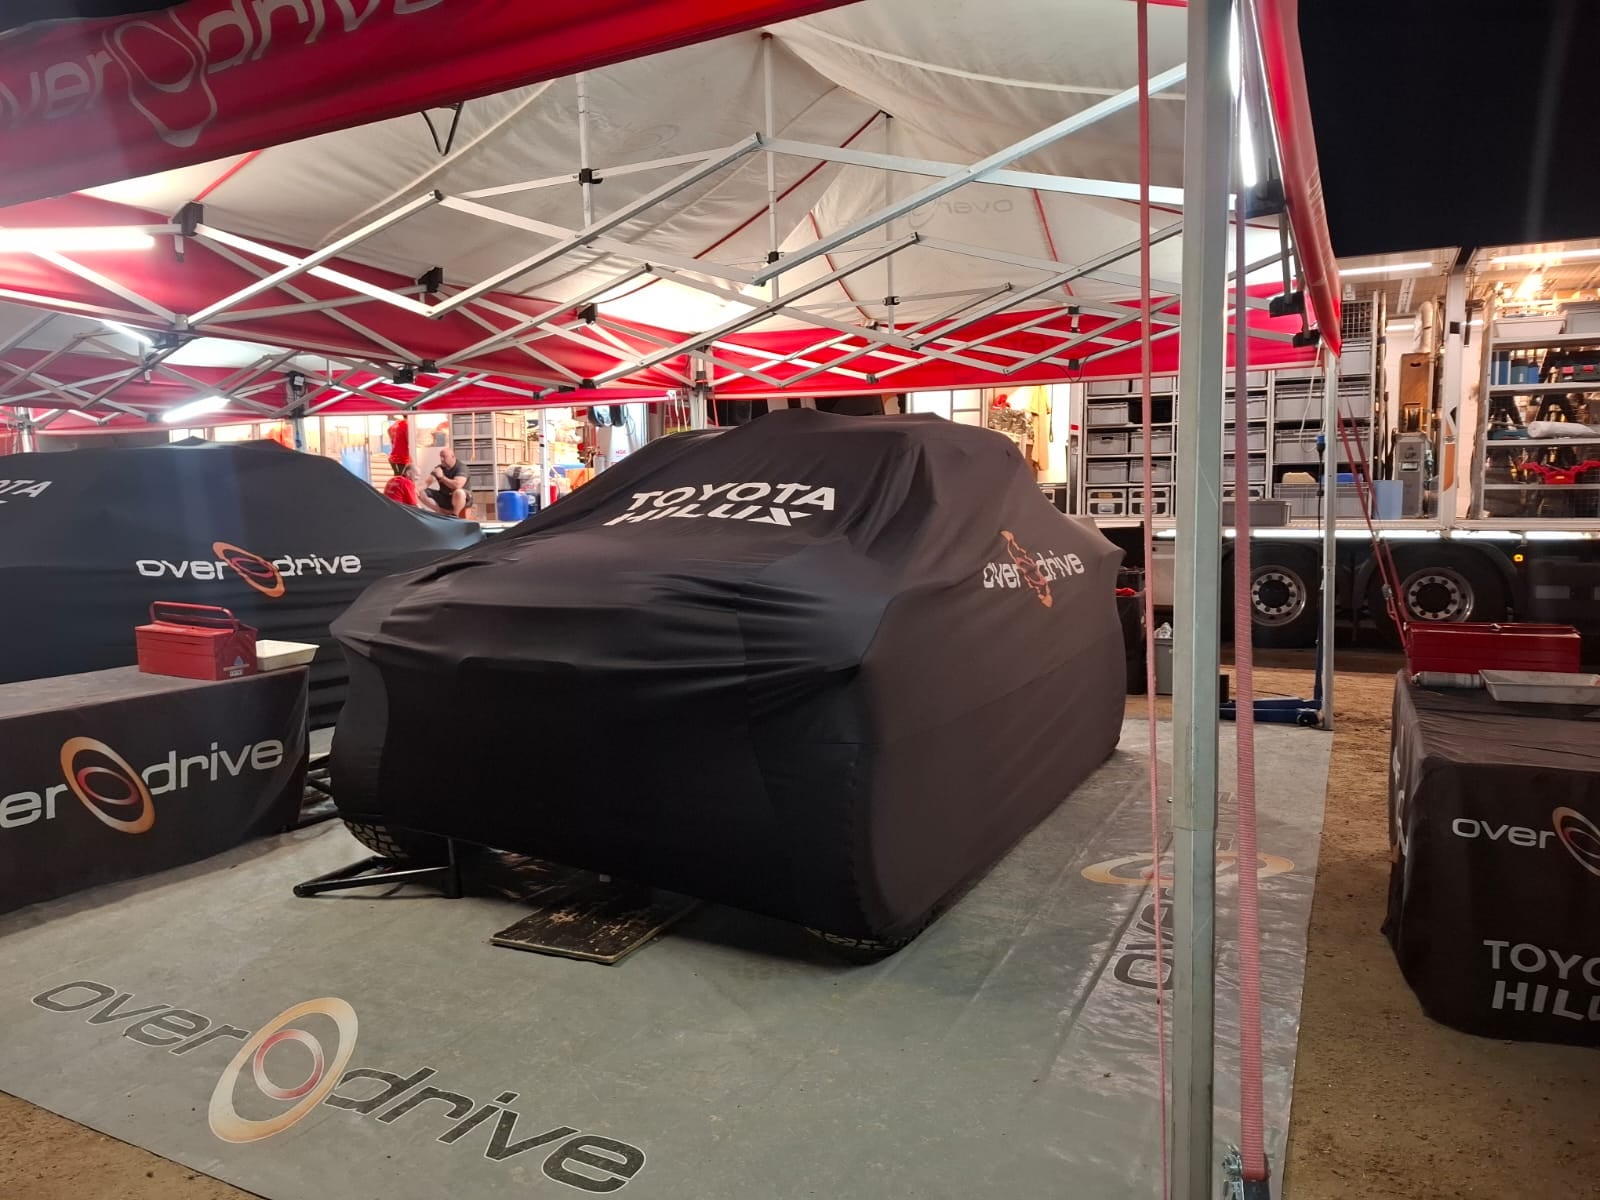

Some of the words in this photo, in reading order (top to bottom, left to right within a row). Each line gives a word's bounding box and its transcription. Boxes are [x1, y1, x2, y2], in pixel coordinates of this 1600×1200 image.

[198, 0, 443, 74] driv
[627, 482, 835, 511] TOYOTA
[602, 503, 813, 527] HILUX
[136, 559, 228, 580] over
[272, 554, 362, 577] drive
[983, 562, 1021, 588] over
[1036, 550, 1085, 582] drive
[142, 739, 284, 796] drive
[1452, 818, 1556, 849] over
[32, 980, 252, 1056] over
[322, 1066, 647, 1194] drive
